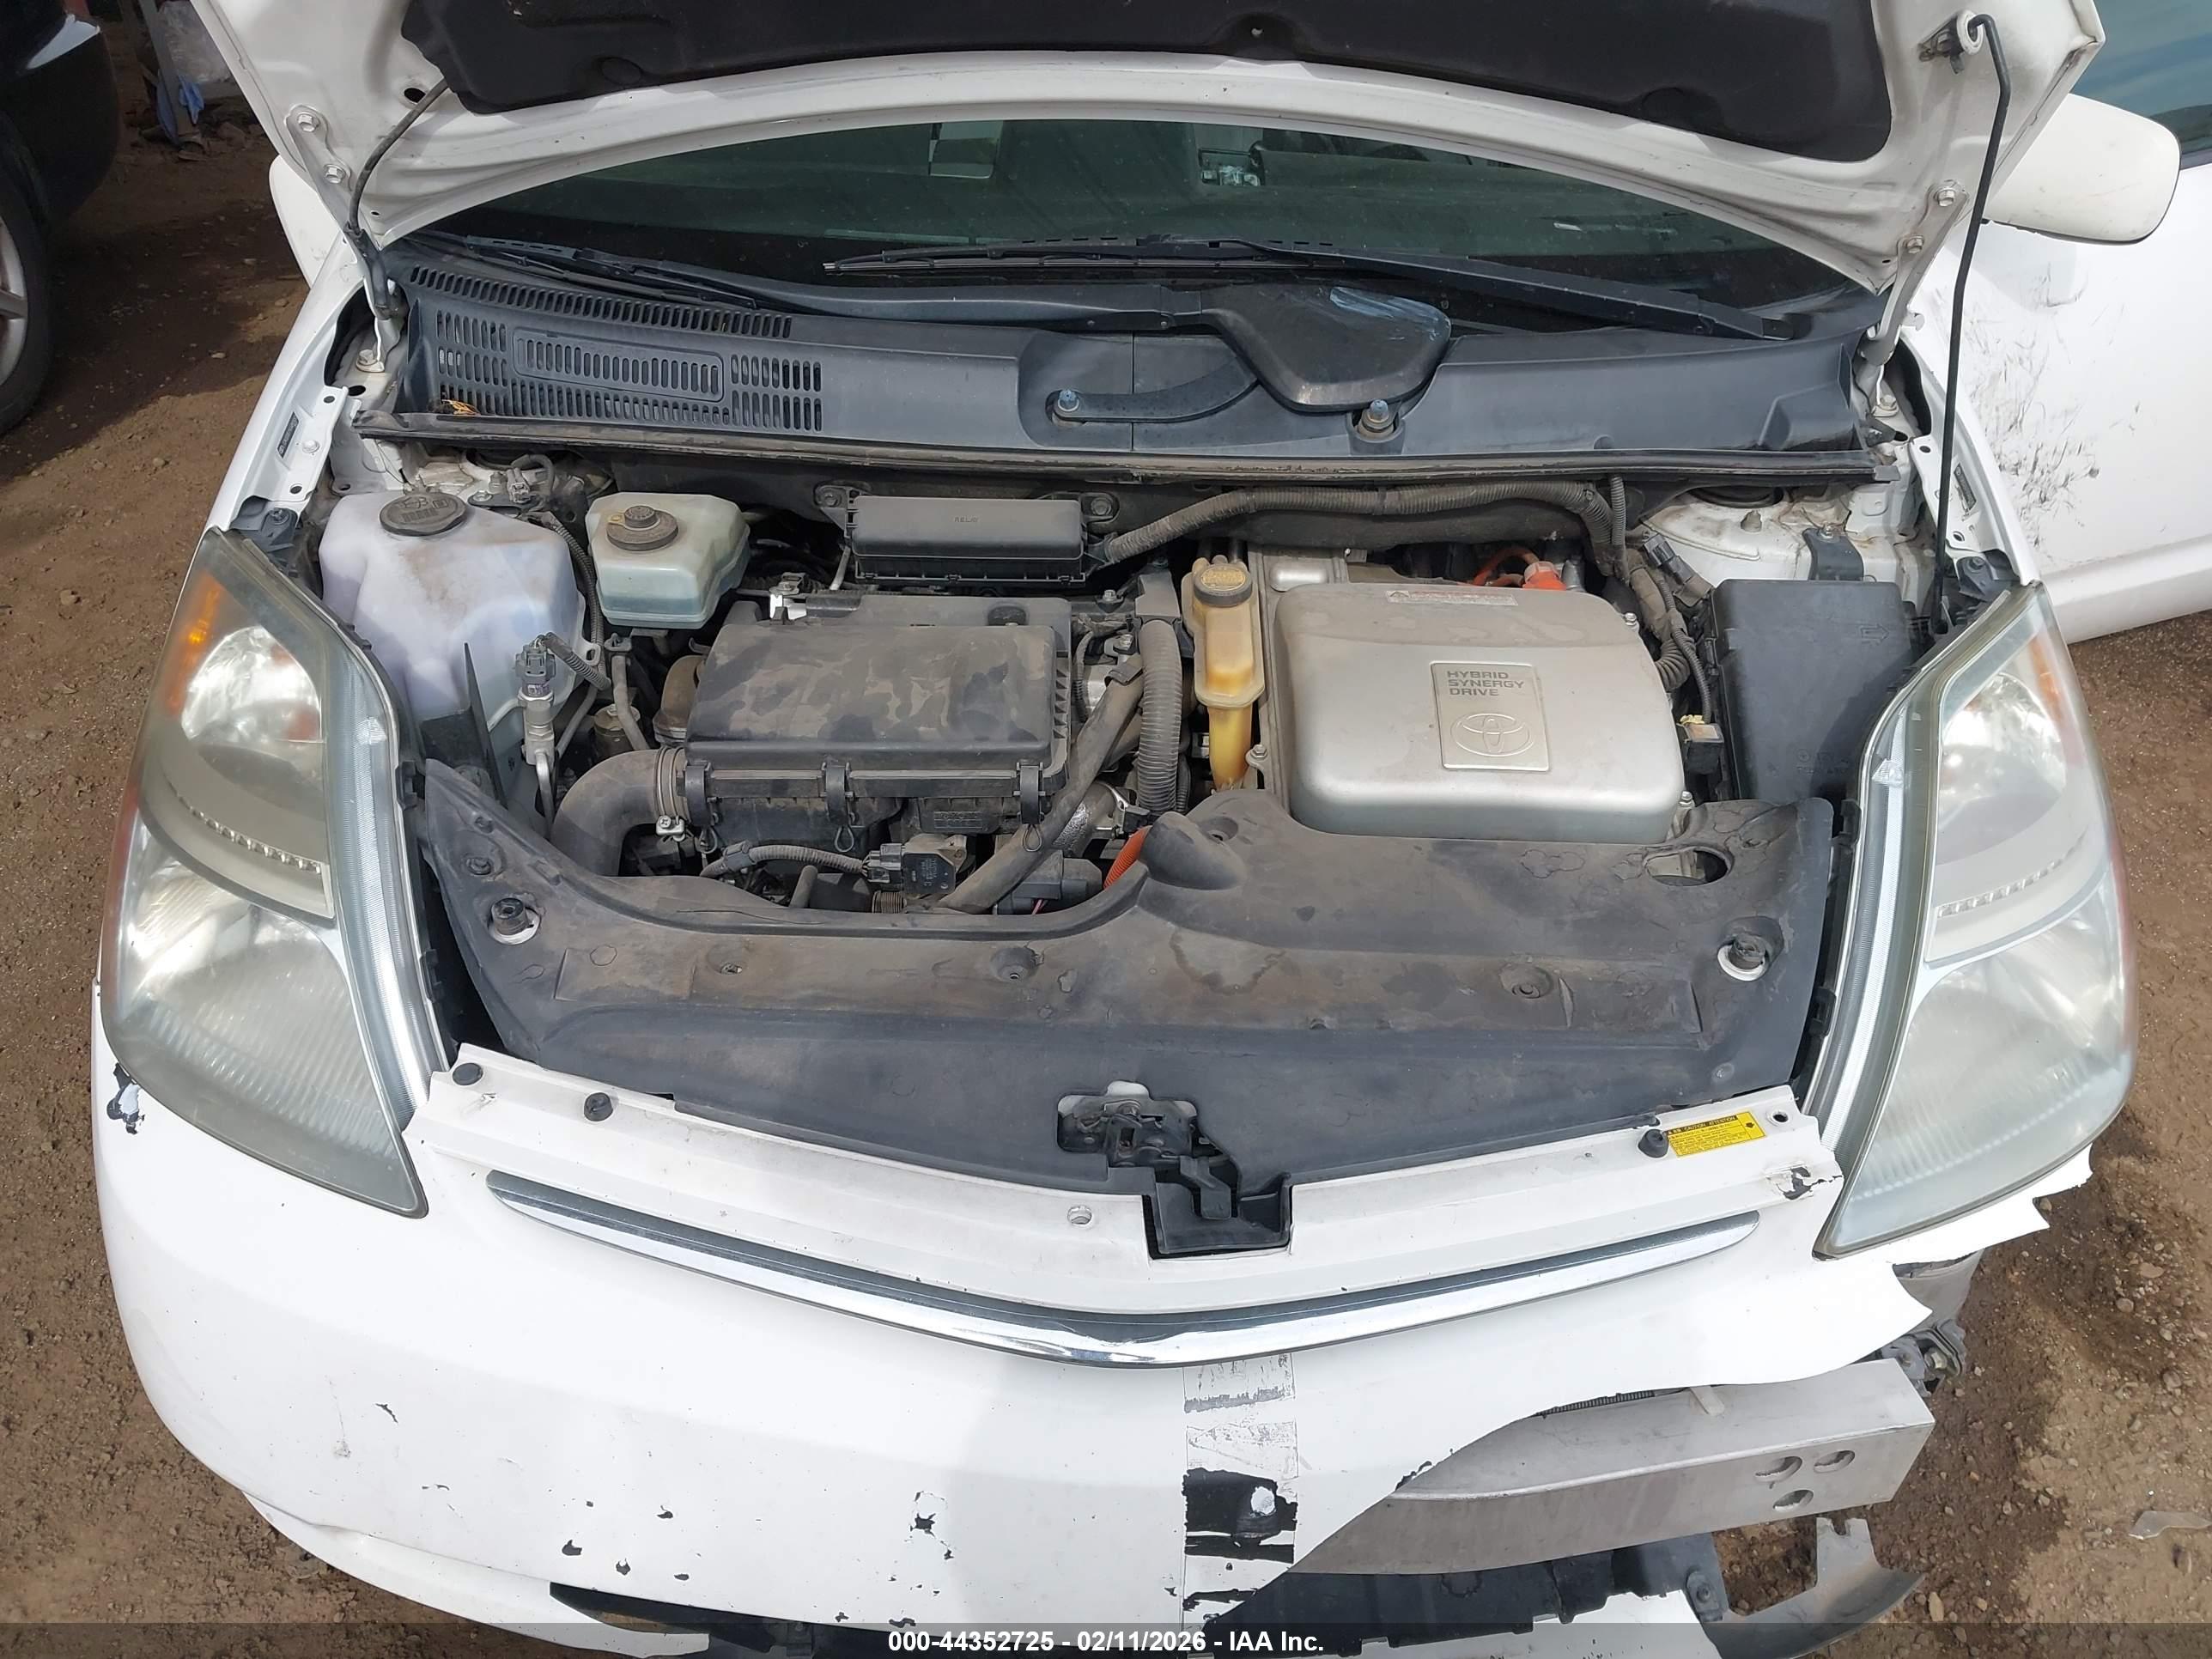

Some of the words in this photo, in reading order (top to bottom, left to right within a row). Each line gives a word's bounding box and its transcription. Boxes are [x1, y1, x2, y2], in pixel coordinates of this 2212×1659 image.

[1447, 671, 1509, 679] HYBRID
[1448, 679, 1524, 689] SYNERGY
[1449, 688, 1498, 696] DRIVE
